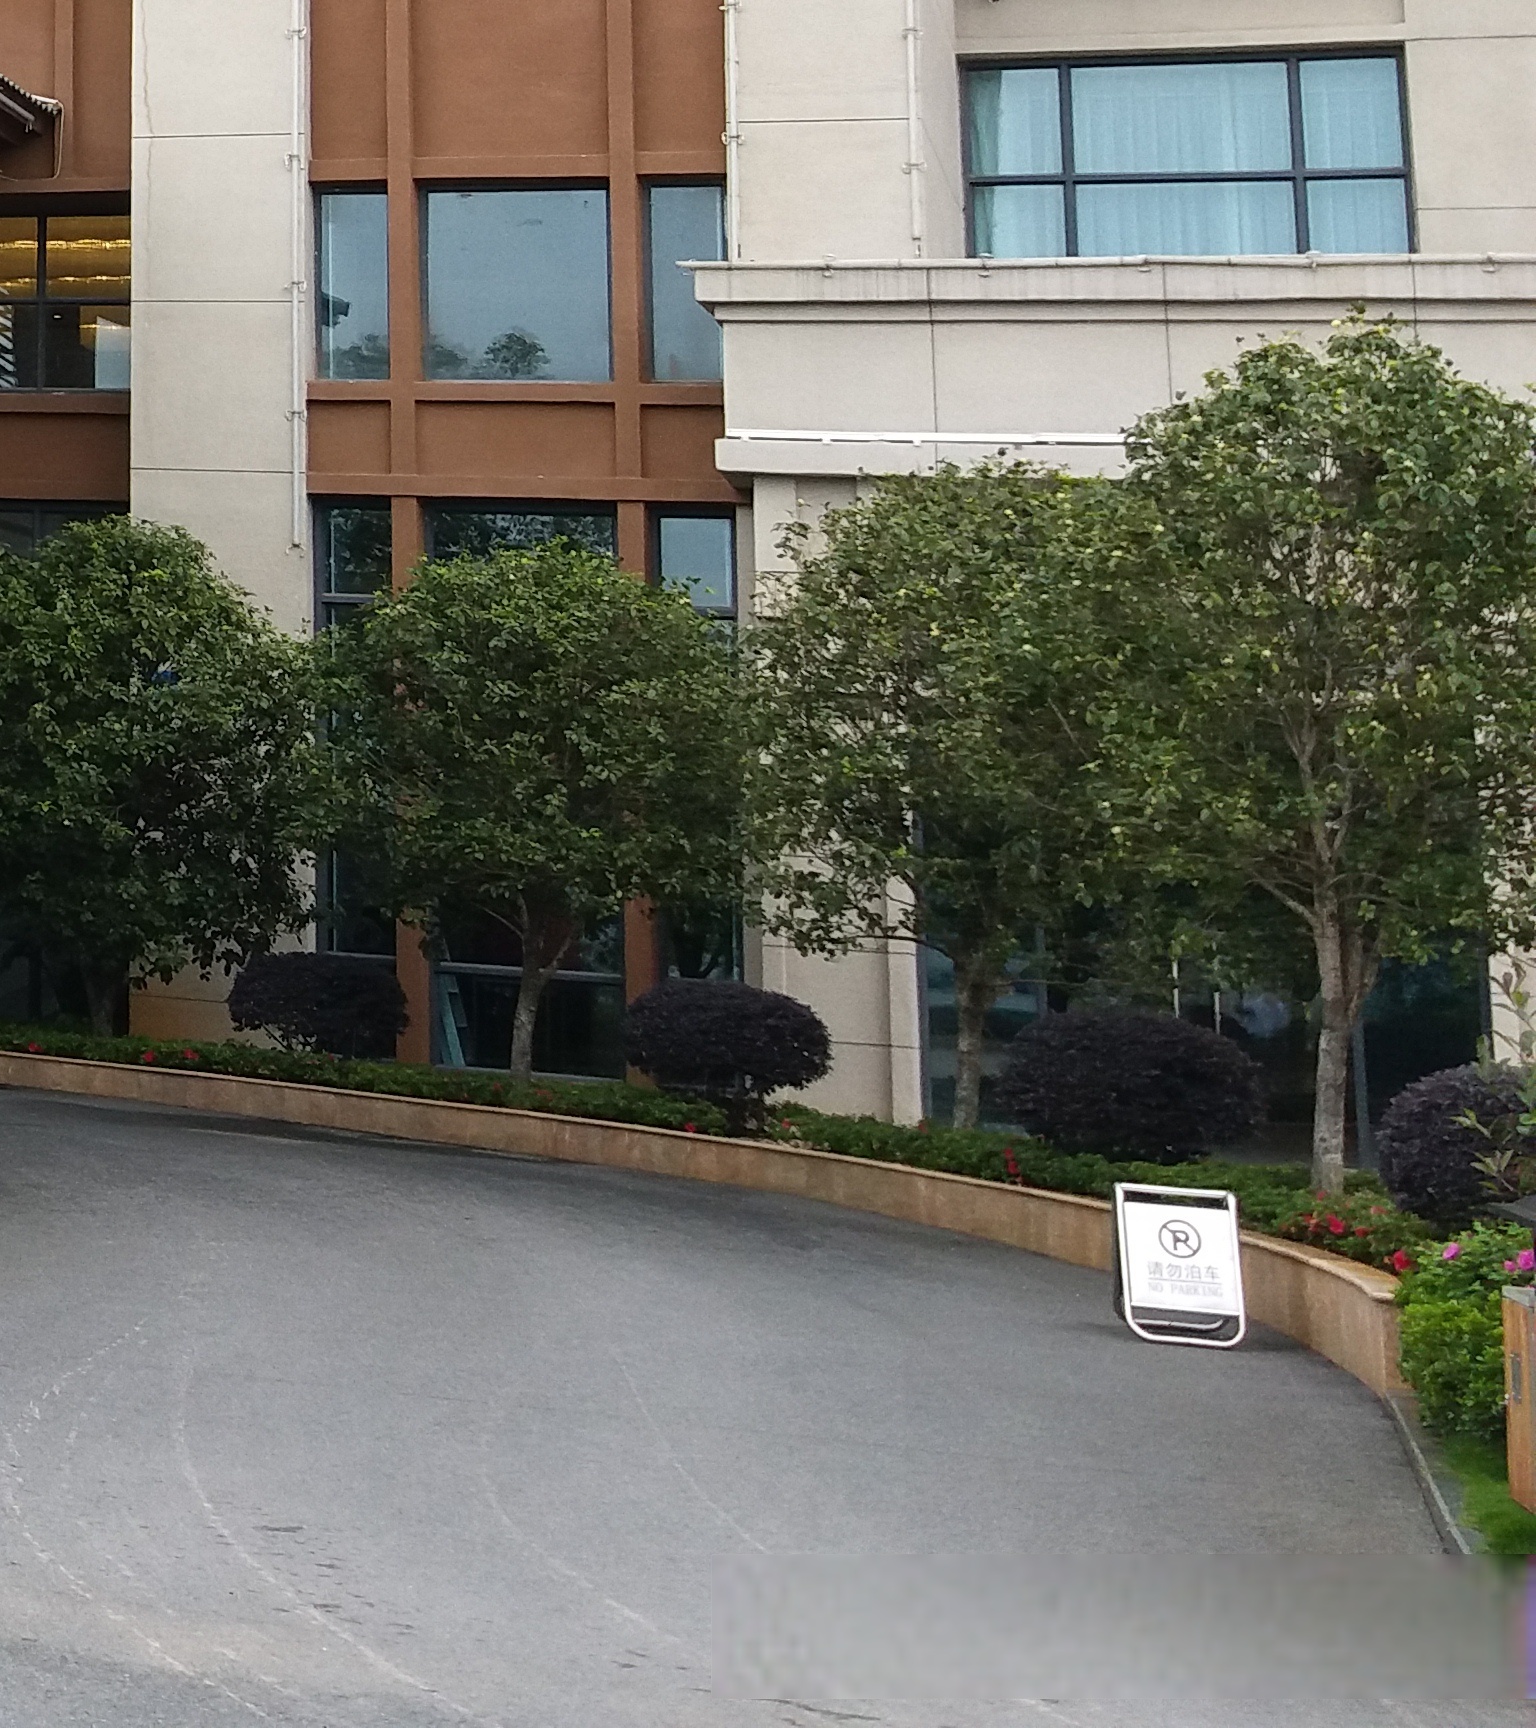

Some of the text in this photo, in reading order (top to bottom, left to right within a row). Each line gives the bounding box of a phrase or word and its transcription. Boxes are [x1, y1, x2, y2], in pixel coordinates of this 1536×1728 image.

[1147, 1261, 1220, 1281] 请勿泊车
[1148, 1282, 1223, 1298] NO PARKING
